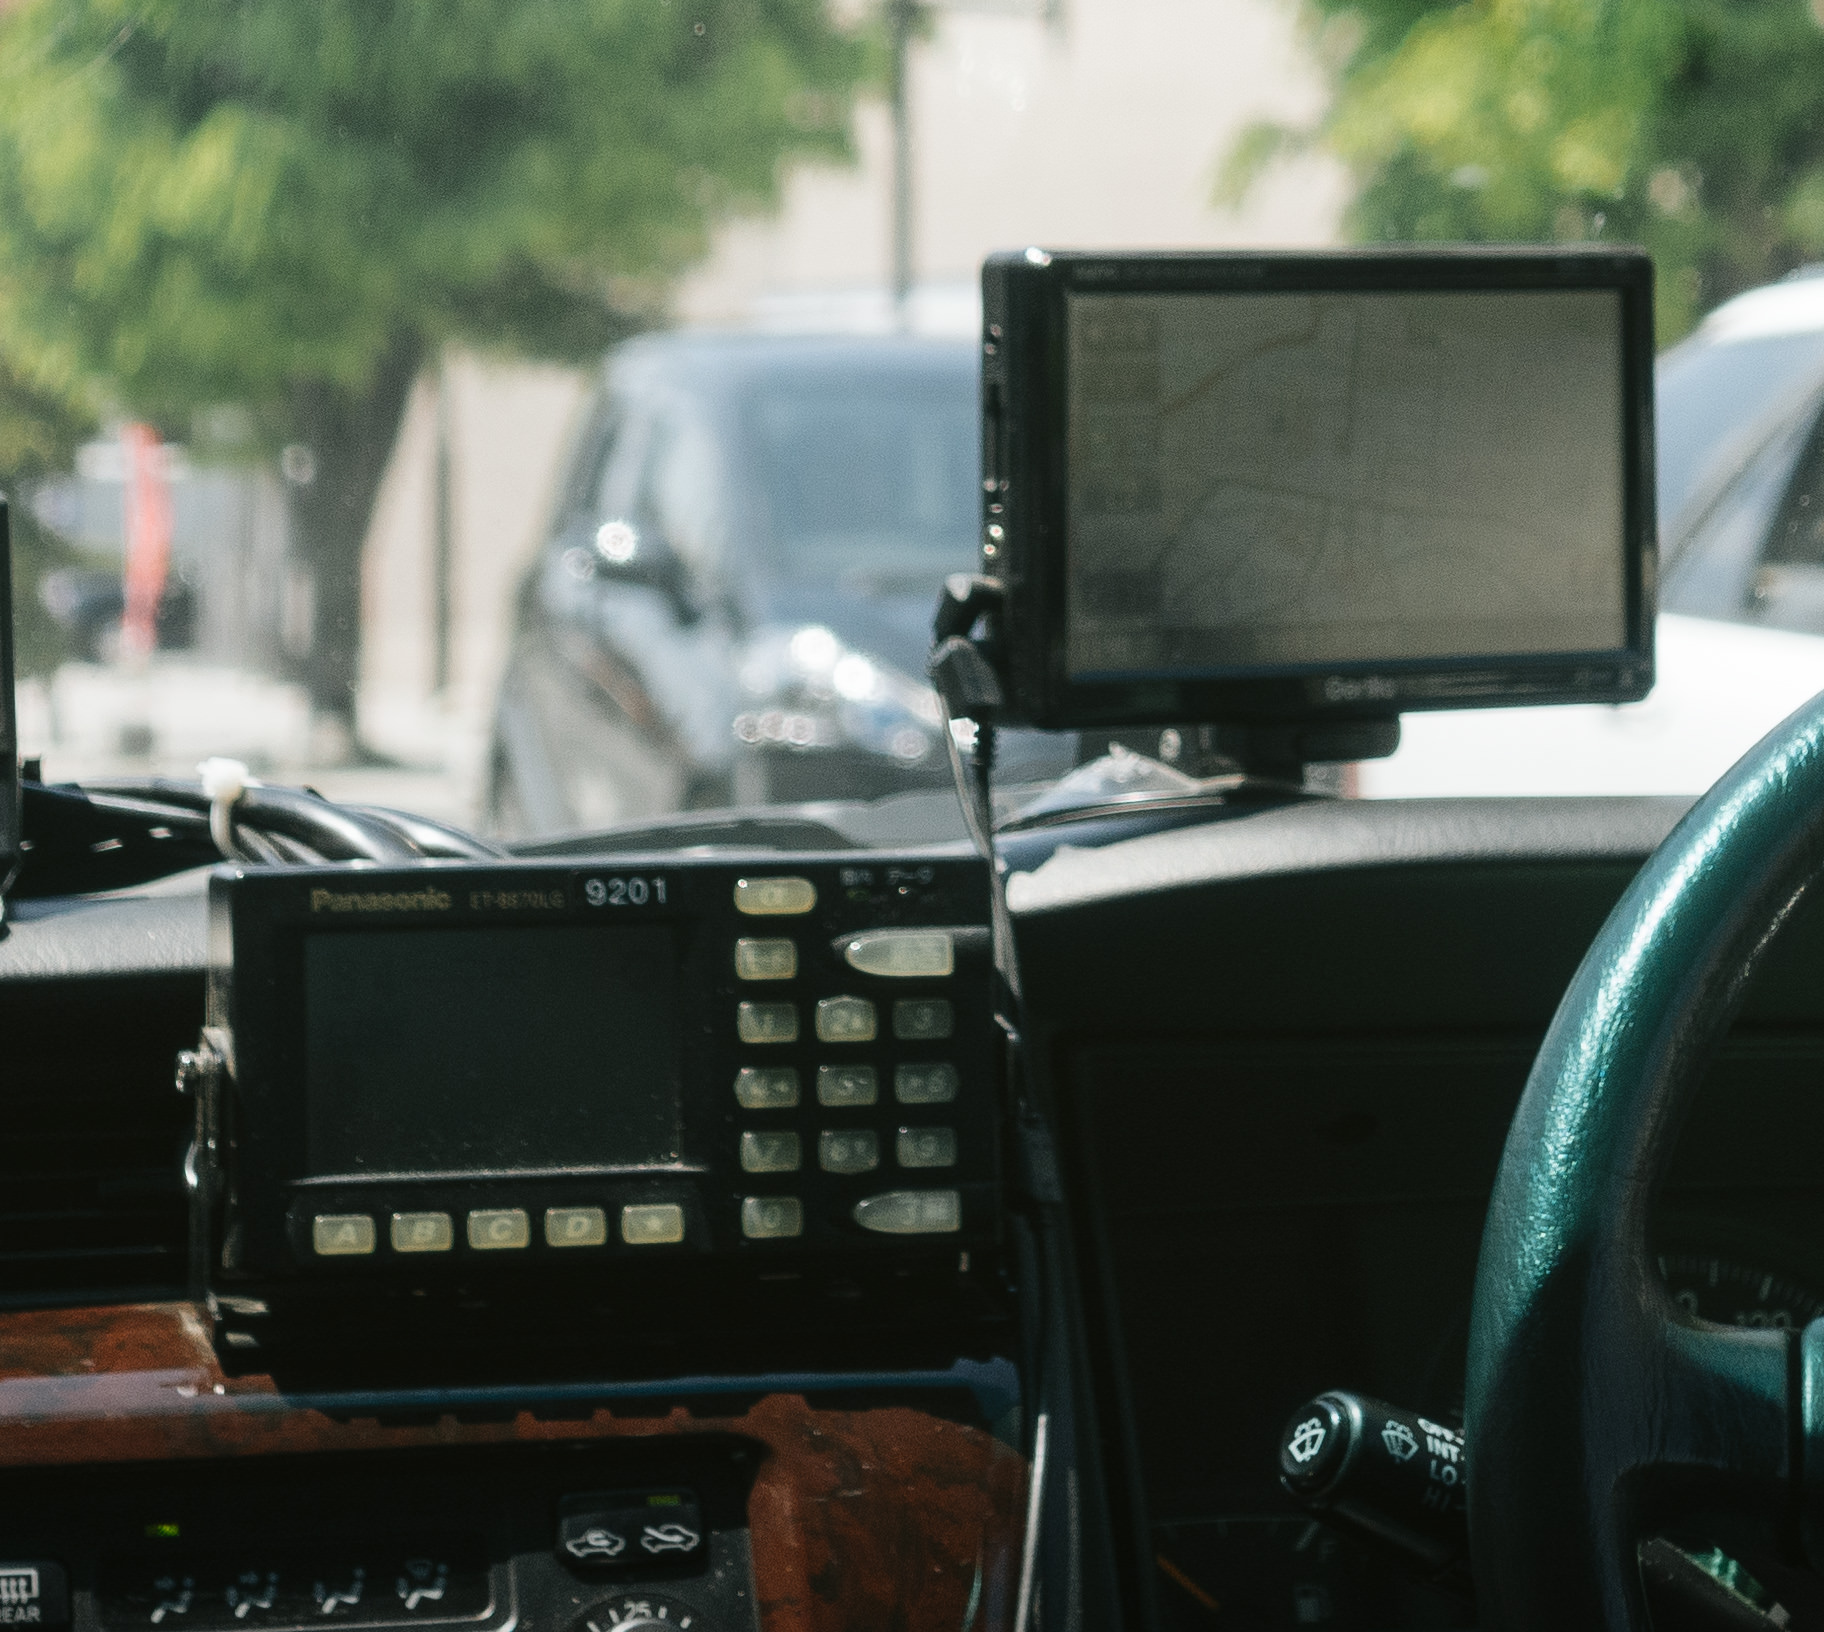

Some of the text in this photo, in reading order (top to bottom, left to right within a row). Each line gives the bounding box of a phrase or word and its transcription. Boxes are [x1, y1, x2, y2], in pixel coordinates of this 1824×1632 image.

[311, 886, 452, 912] Panasonic
[584, 876, 669, 906] 9201
[333, 1222, 358, 1246] A
[410, 1220, 437, 1244] B
[487, 1217, 513, 1241] C
[565, 1215, 592, 1239] D
[1426, 1434, 1461, 1463] INT
[1430, 1458, 1458, 1486] LO
